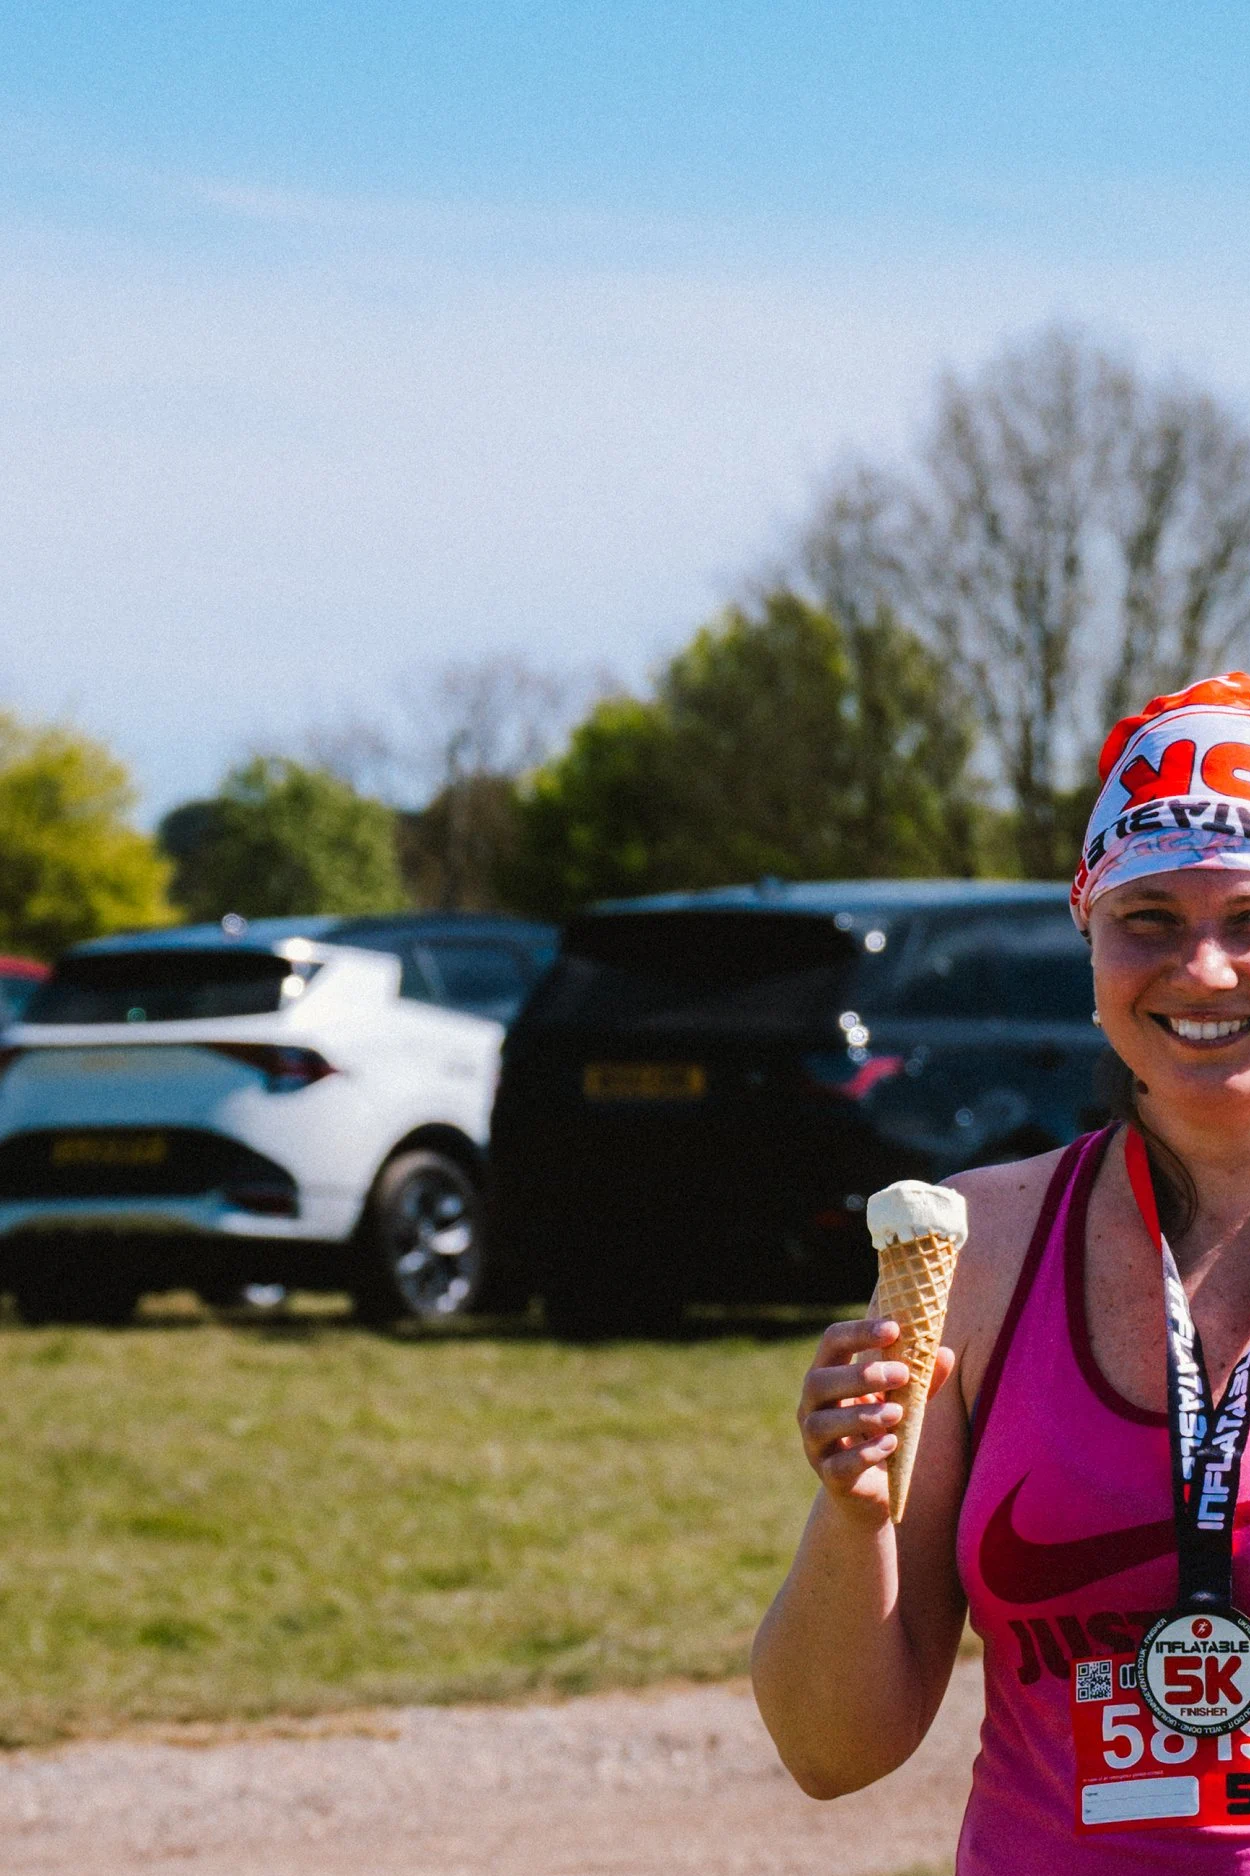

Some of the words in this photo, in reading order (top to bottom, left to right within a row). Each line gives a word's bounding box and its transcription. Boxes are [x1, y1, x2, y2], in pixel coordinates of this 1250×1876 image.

[1155, 1641, 1249, 1653] INFLATABLE
[1164, 1655, 1243, 1705] 5K
[1180, 1707, 1228, 1717] FINISHER
[1204, 1725, 1222, 1734] WELL
